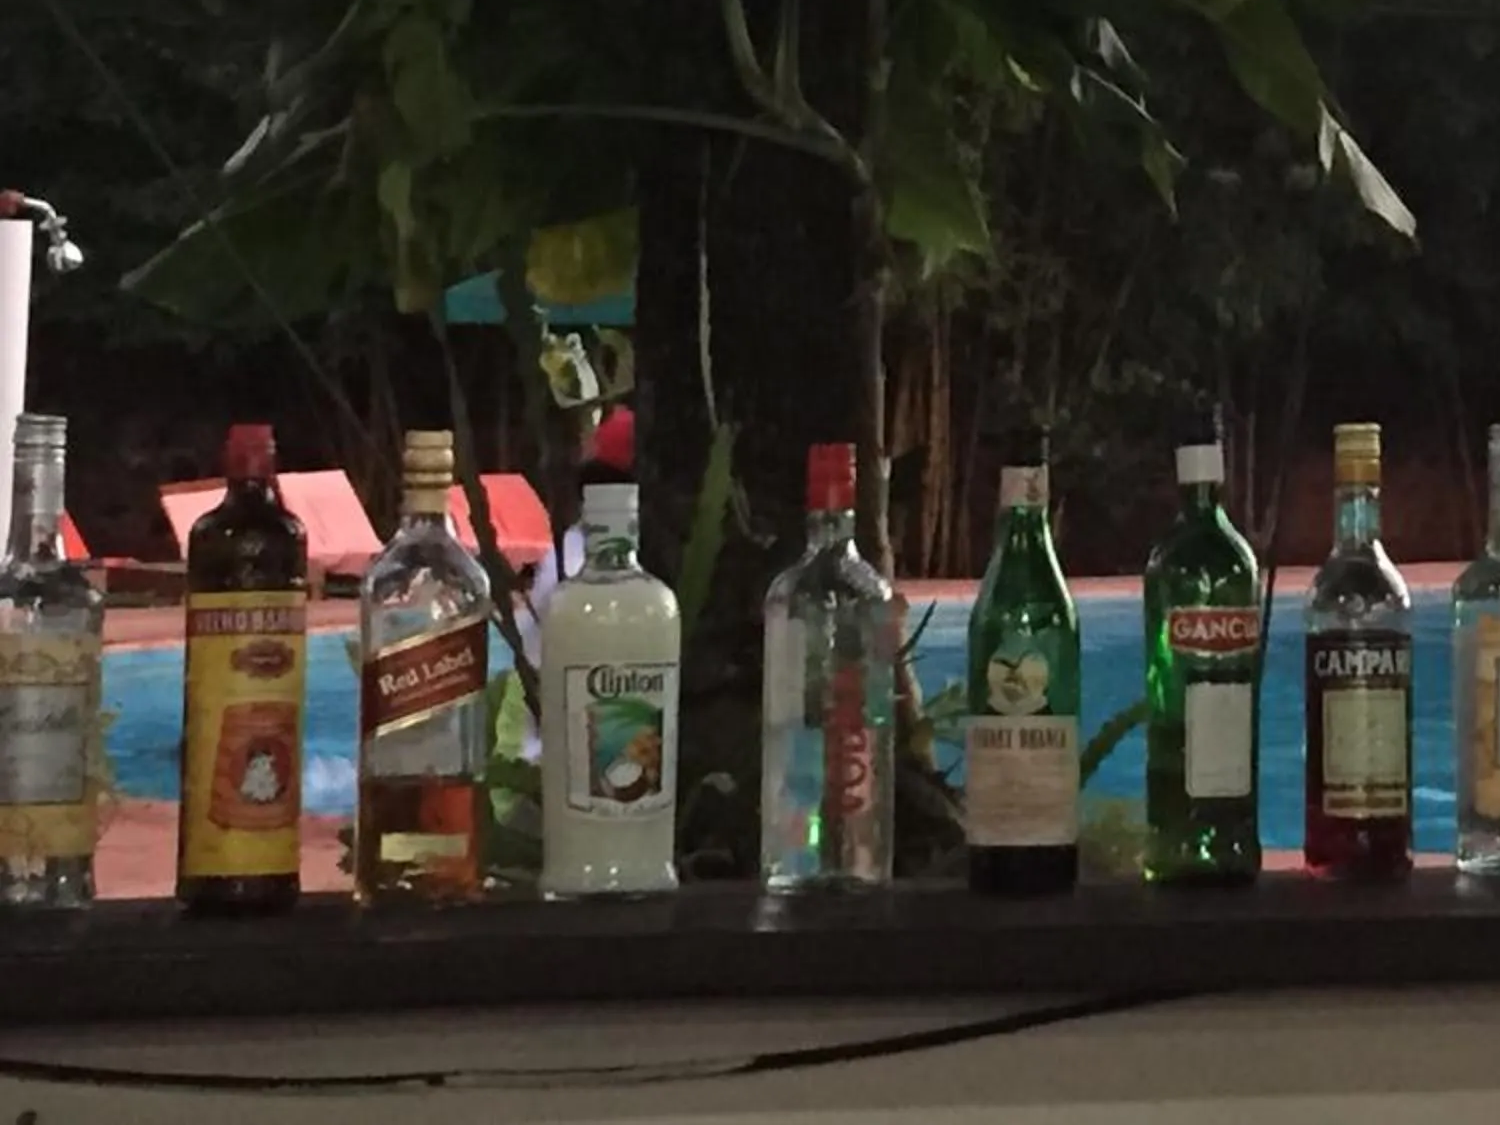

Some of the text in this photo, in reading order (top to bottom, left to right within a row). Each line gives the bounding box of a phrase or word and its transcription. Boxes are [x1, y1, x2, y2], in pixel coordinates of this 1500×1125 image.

[378, 667, 419, 696] Red
[421, 645, 474, 682] Label
[1314, 648, 1410, 676] CAMPAR
[586, 664, 664, 700] Clinton
